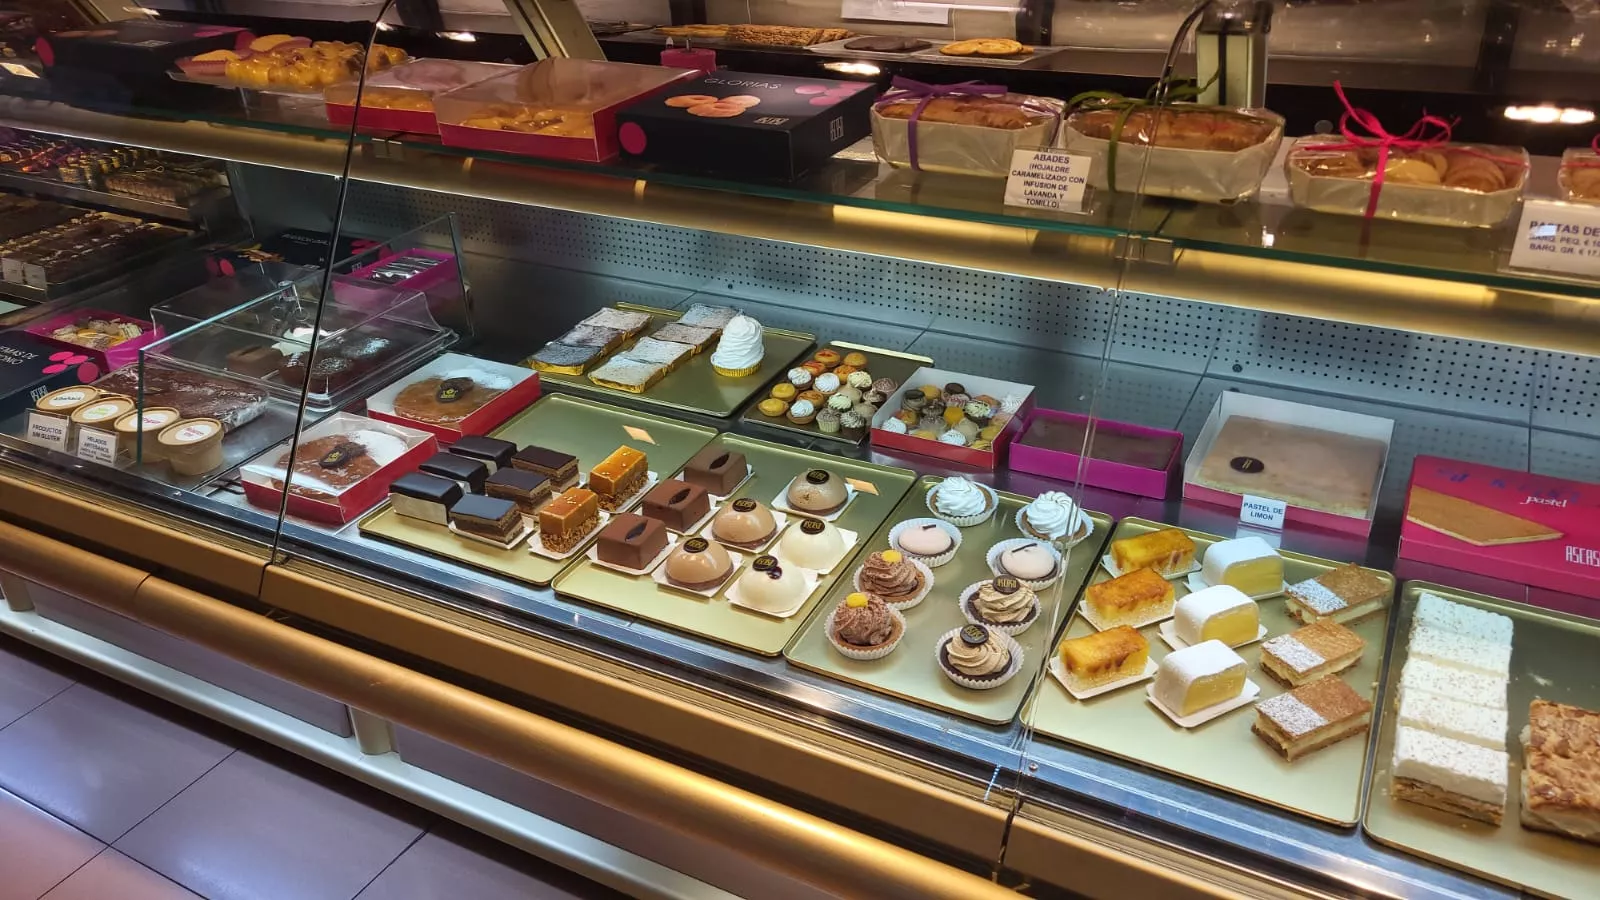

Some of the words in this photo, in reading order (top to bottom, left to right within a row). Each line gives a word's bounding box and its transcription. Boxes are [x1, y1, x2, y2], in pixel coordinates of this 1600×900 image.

[704, 78, 782, 89] GLORIAS
[1033, 154, 1070, 164] ABADES
[1029, 163, 1070, 174] (HOJALDRE
[1011, 170, 1067, 182] CARAMELIZADO
[1023, 181, 1057, 190] INFUSION
[1024, 190, 1057, 199] LAVANDA
[1026, 199, 1060, 208] TOMILLO)
[1530, 221, 1579, 234] PTAS
[32, 424, 62, 435] PRODUCTOS
[1243, 502, 1270, 513] PASTEL
[1520, 496, 1568, 508] pastel
[1250, 512, 1274, 521] LIMON
